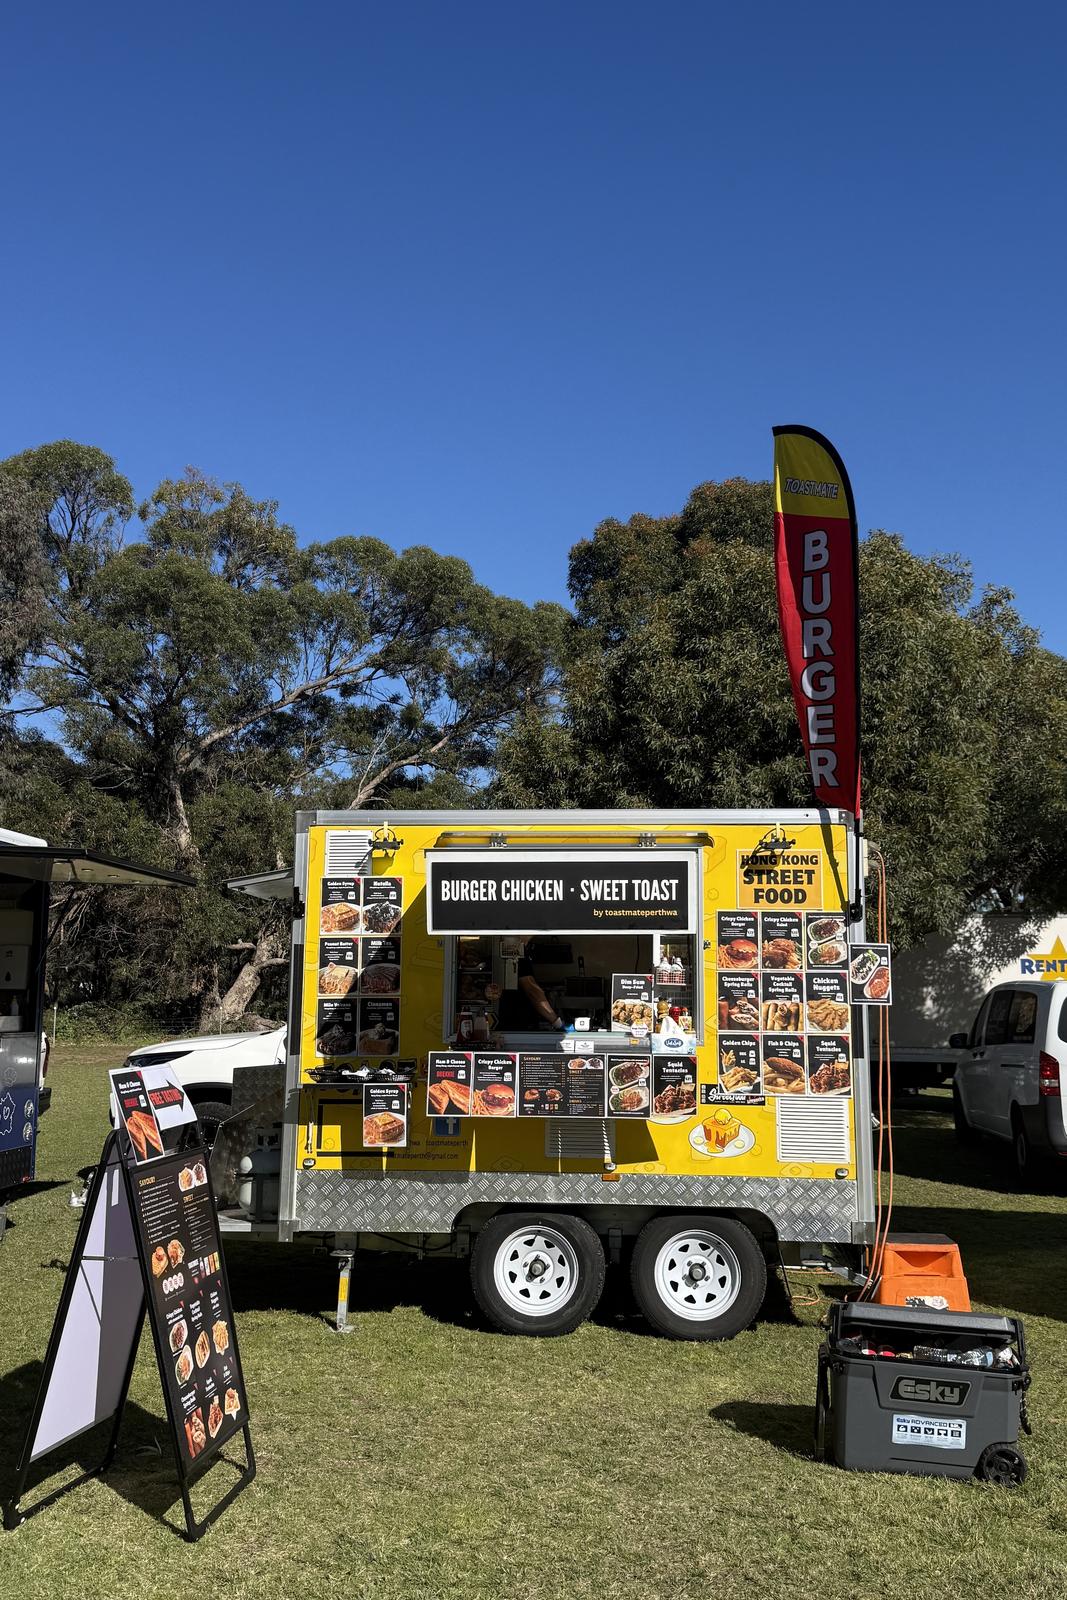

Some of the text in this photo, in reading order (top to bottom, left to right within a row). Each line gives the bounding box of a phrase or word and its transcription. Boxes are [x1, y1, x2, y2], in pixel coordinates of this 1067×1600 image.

[784, 478, 839, 499] TOASTMATE
[802, 530, 839, 787] BURGER
[741, 855, 818, 865] HONG KONG
[743, 870, 815, 885] STREET
[441, 880, 497, 901] BURGER
[501, 880, 563, 901] CHICKEN
[580, 880, 628, 901] SWEET
[632, 880, 678, 901] TOAST
[754, 888, 806, 904] FOOD
[594, 909, 678, 918] by toastmateperthwa
[898, 1380, 960, 1403] Esky
[911, 1419, 947, 1427] ADVANCED
